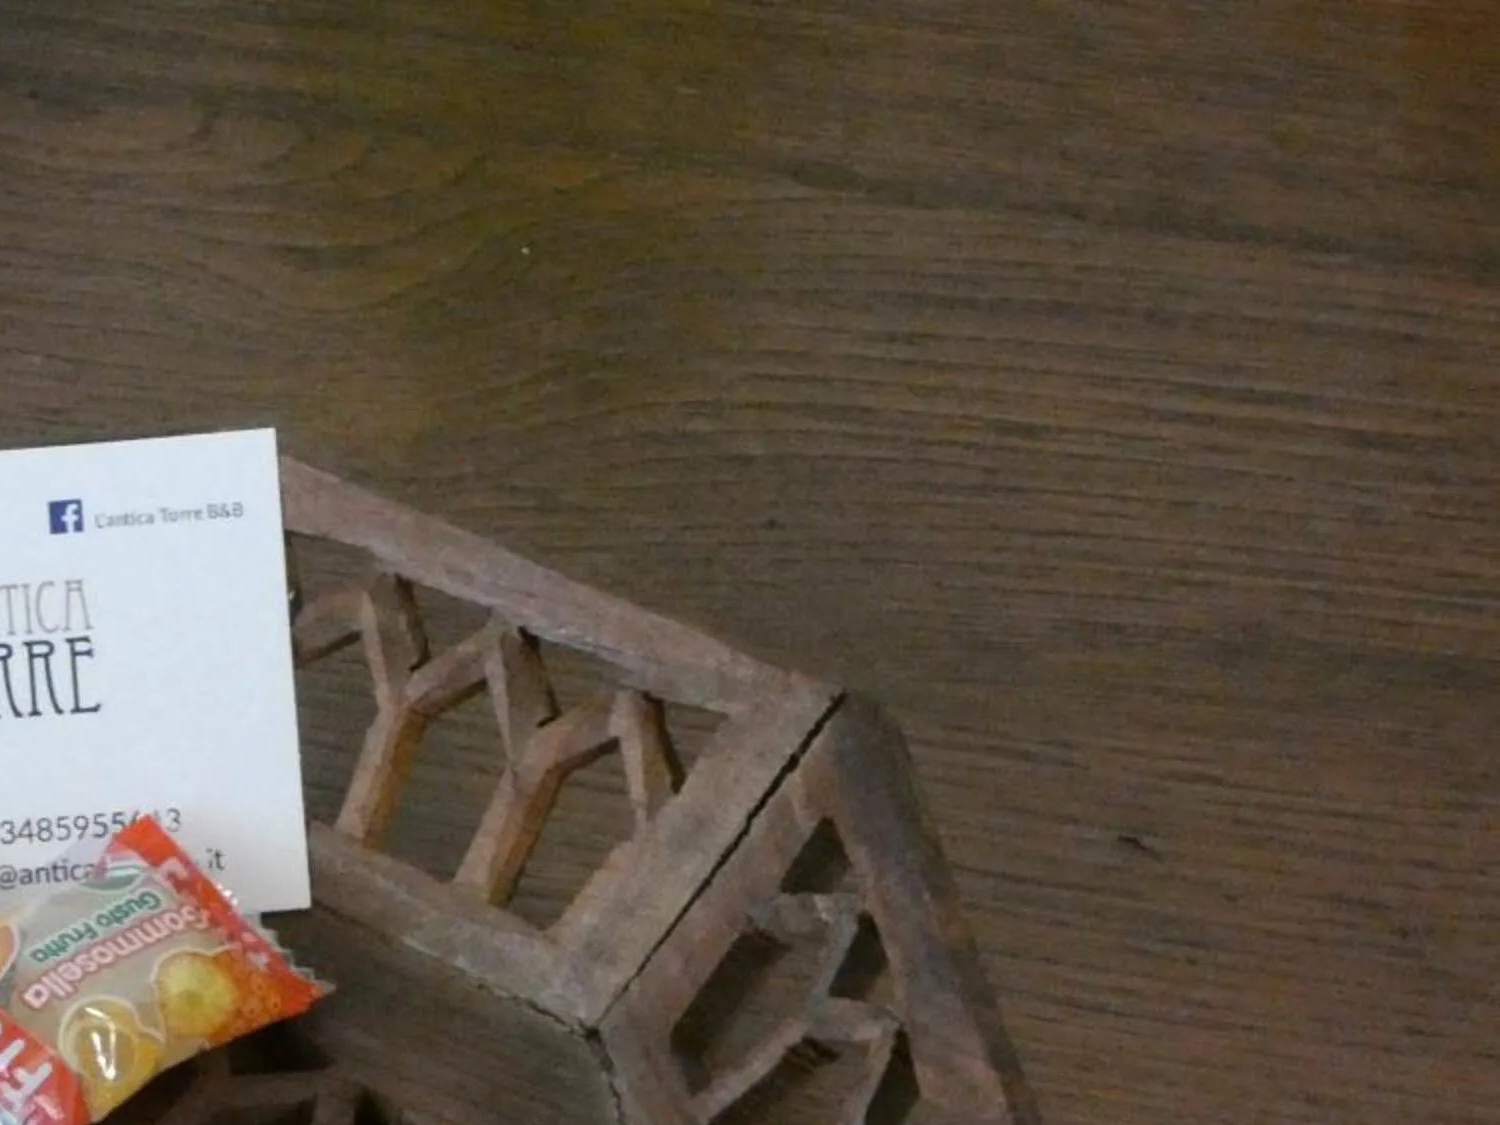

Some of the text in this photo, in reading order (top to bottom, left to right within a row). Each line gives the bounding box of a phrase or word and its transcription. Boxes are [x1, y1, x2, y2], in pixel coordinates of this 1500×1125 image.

[159, 505, 203, 523] Torre
[206, 501, 244, 519] B&B
[1, 808, 182, 845] 34859553
[29, 890, 163, 963] Gusto Frutta
